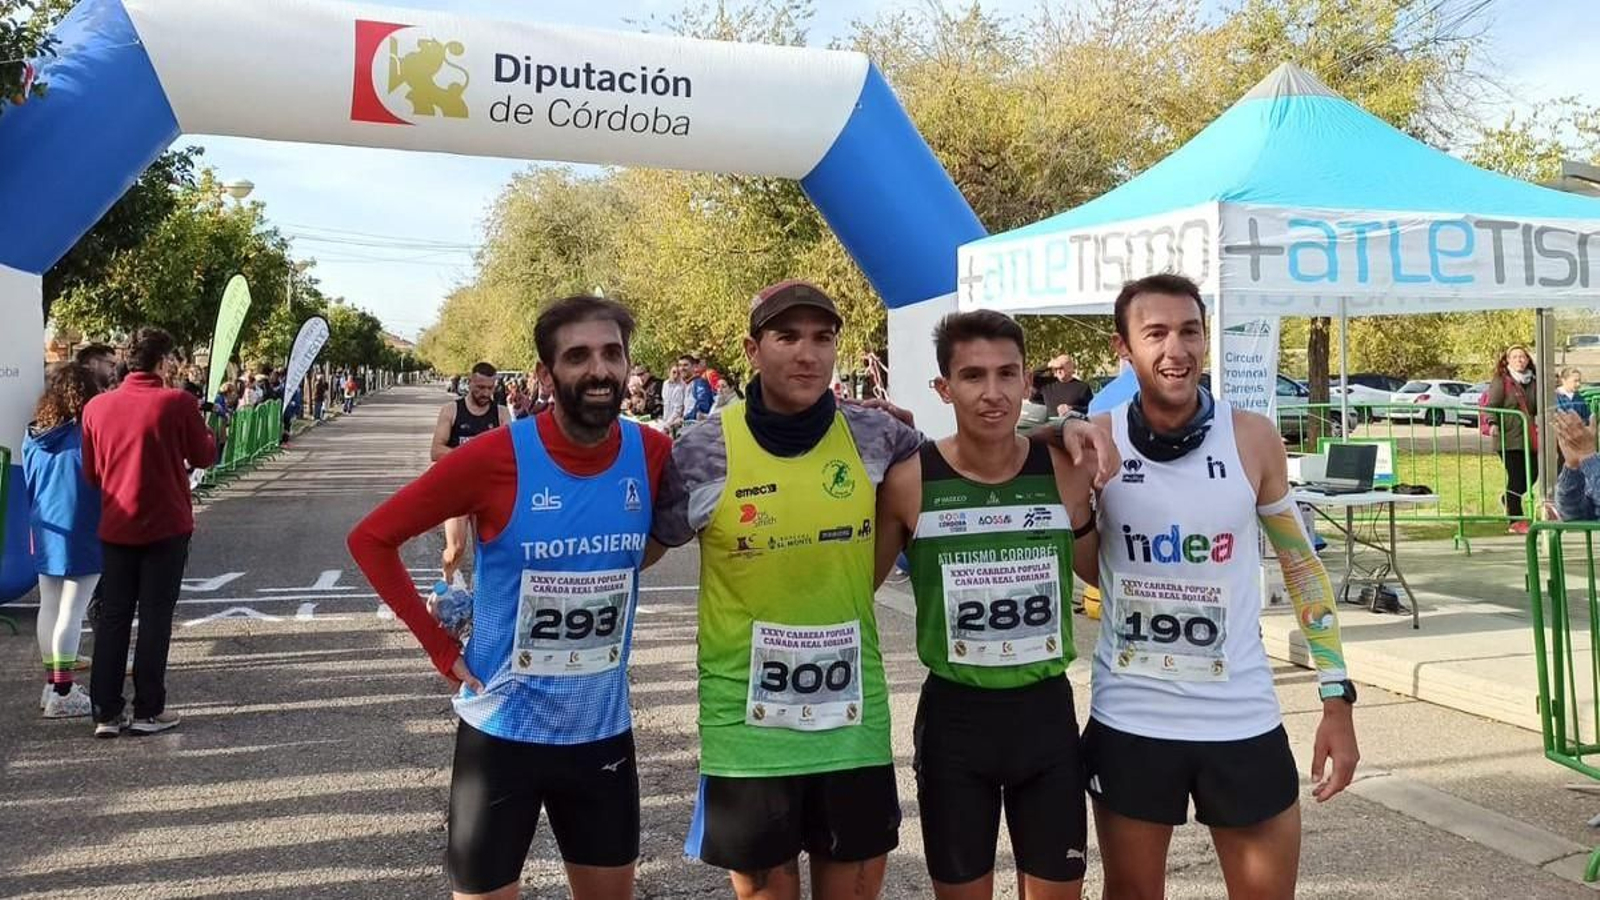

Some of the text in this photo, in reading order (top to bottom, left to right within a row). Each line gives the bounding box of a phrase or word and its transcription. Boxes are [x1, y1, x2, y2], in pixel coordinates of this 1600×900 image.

[494, 53, 692, 98] Diputación
[489, 94, 691, 136] de Córdoba
[531, 486, 562, 511] als
[1122, 524, 1235, 563] indea
[937, 549, 997, 566] ATLETISMO
[950, 562, 1051, 578] XXXV CARRERA POPULAR
[992, 574, 1015, 585] REAL
[1015, 571, 1051, 583] SORIANA
[530, 575, 555, 585] XXXV
[557, 576, 597, 586] CARRERA
[1121, 579, 1145, 589] XXXV
[1144, 581, 1183, 592] CARRERA
[532, 584, 570, 595] CAÑADA
[571, 585, 593, 595] REAL
[1158, 590, 1181, 600] REAL
[957, 595, 1052, 632] 288
[530, 605, 618, 640] 293
[1125, 611, 1218, 647] 190
[760, 626, 854, 639] XXXV CARRERA POPULAR
[800, 639, 822, 649] REAL
[760, 660, 851, 694] 300
